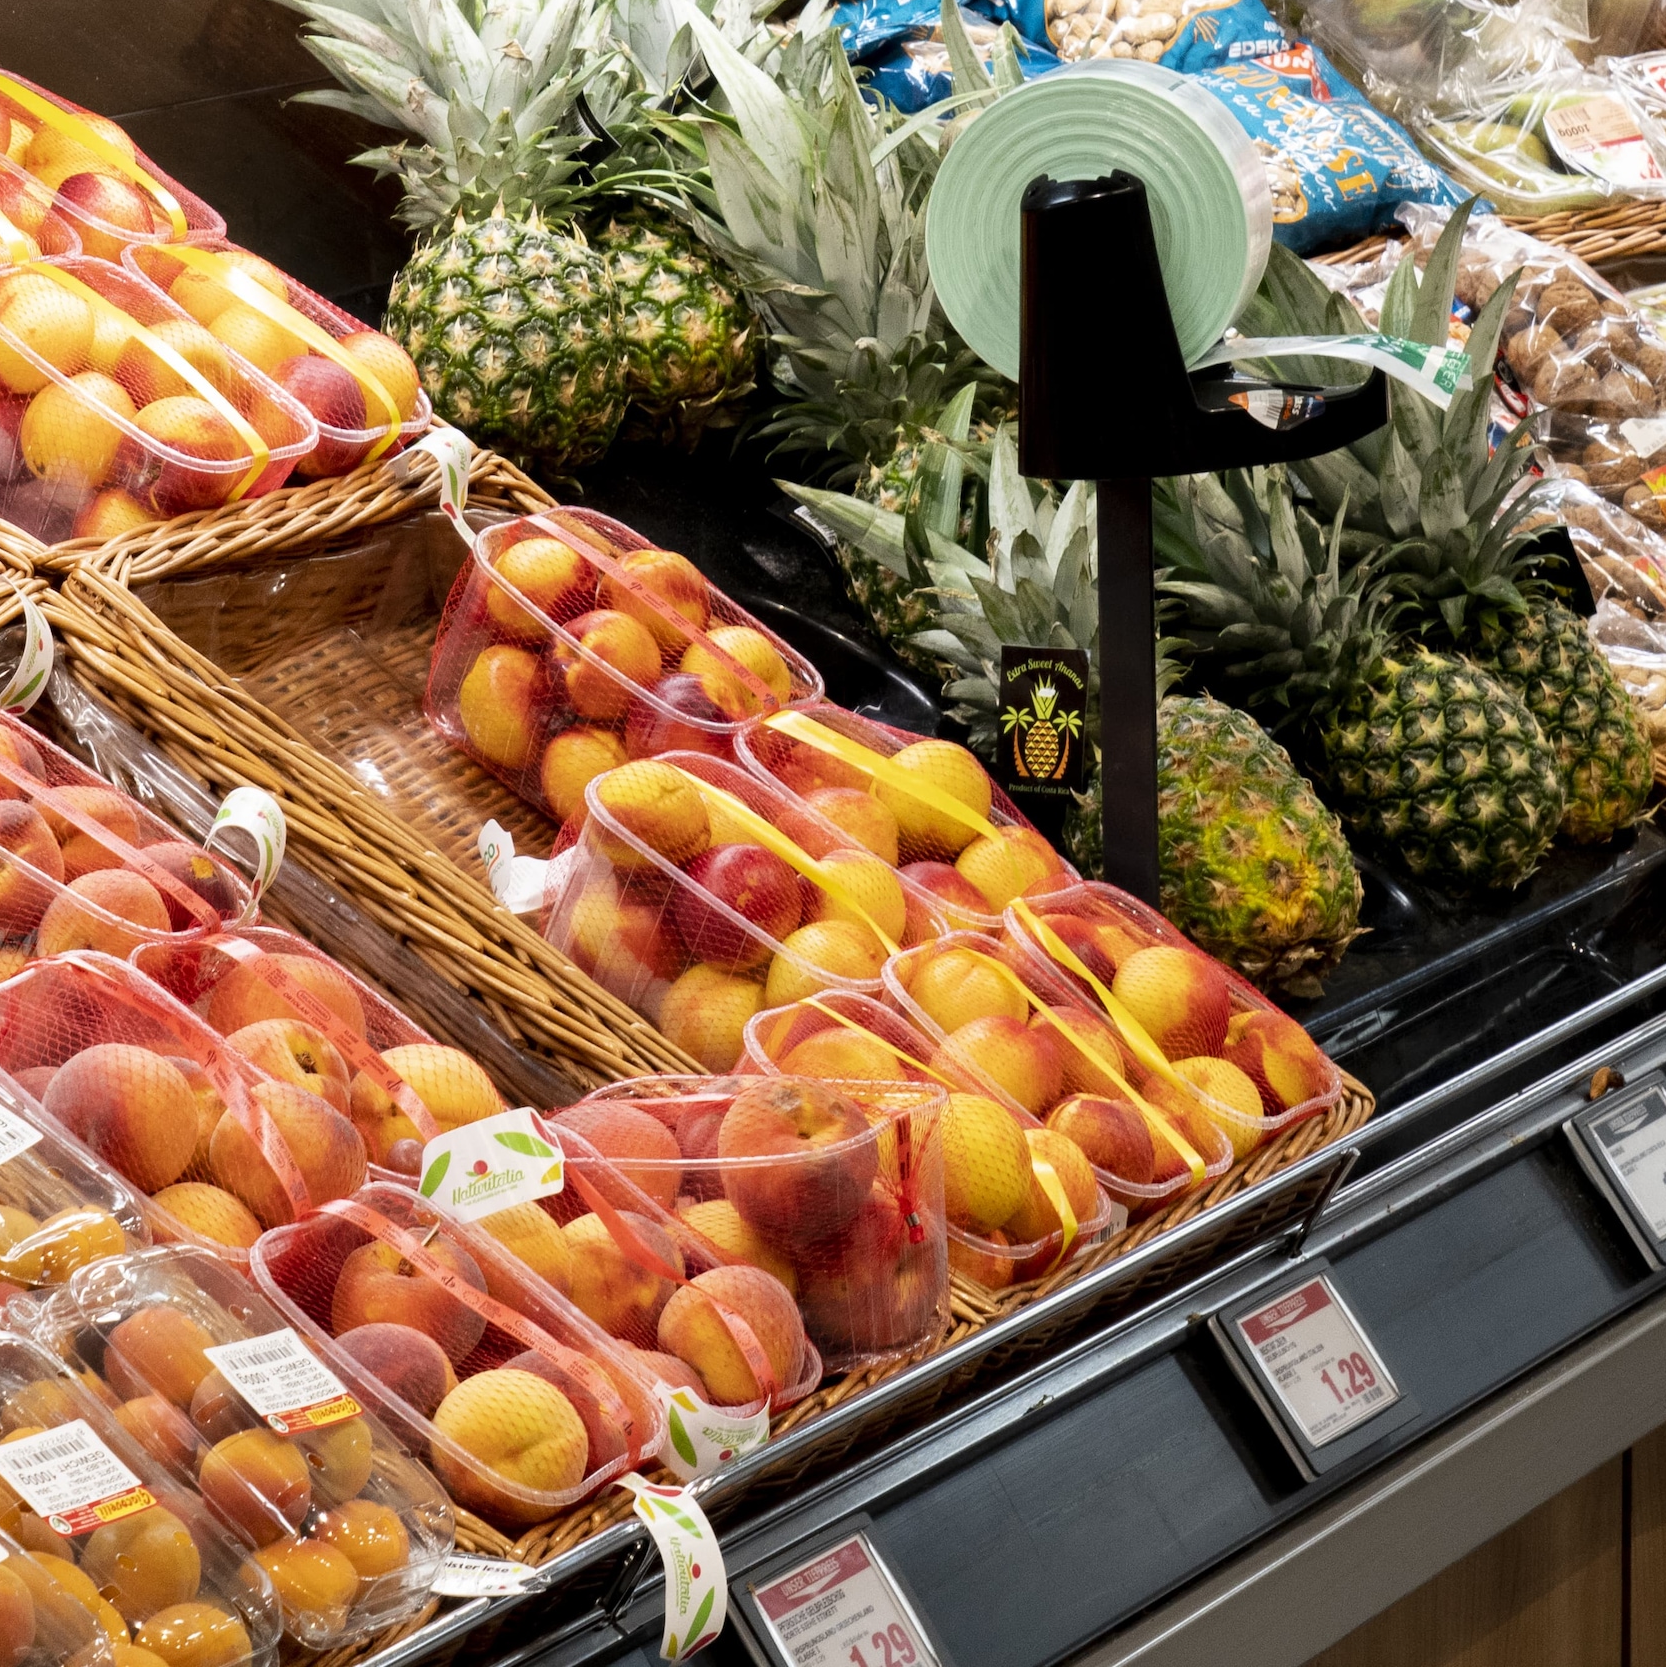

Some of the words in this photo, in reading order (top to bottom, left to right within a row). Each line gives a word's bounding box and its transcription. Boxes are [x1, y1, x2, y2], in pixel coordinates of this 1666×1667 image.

[1228, 38, 1291, 58] EDEKA
[1558, 123, 1591, 137] 1000g
[1006, 661, 1028, 683] Extra
[1027, 657, 1053, 671] Sweet
[1054, 660, 1084, 690] Ananas
[1008, 783, 1033, 793] Product
[1041, 785, 1057, 794] Costa
[1057, 786, 1070, 795] Rica
[452, 1168, 525, 1206] Naturitalia
[1277, 1293, 1307, 1317] TIERPREIS
[236, 1372, 271, 1386] 1000g
[1320, 1351, 1377, 1405] 1.29
[310, 1396, 357, 1422] Giacovelli
[17, 1470, 58, 1486] 1000g
[98, 1488, 151, 1520] Giacovelli
[670, 1536, 692, 1617] Naturitalia
[780, 1575, 805, 1598] UNSER
[804, 1556, 841, 1583] TIERPREIS
[835, 1604, 876, 1632] GRIECHENLAND
[849, 1622, 917, 1667] 129
